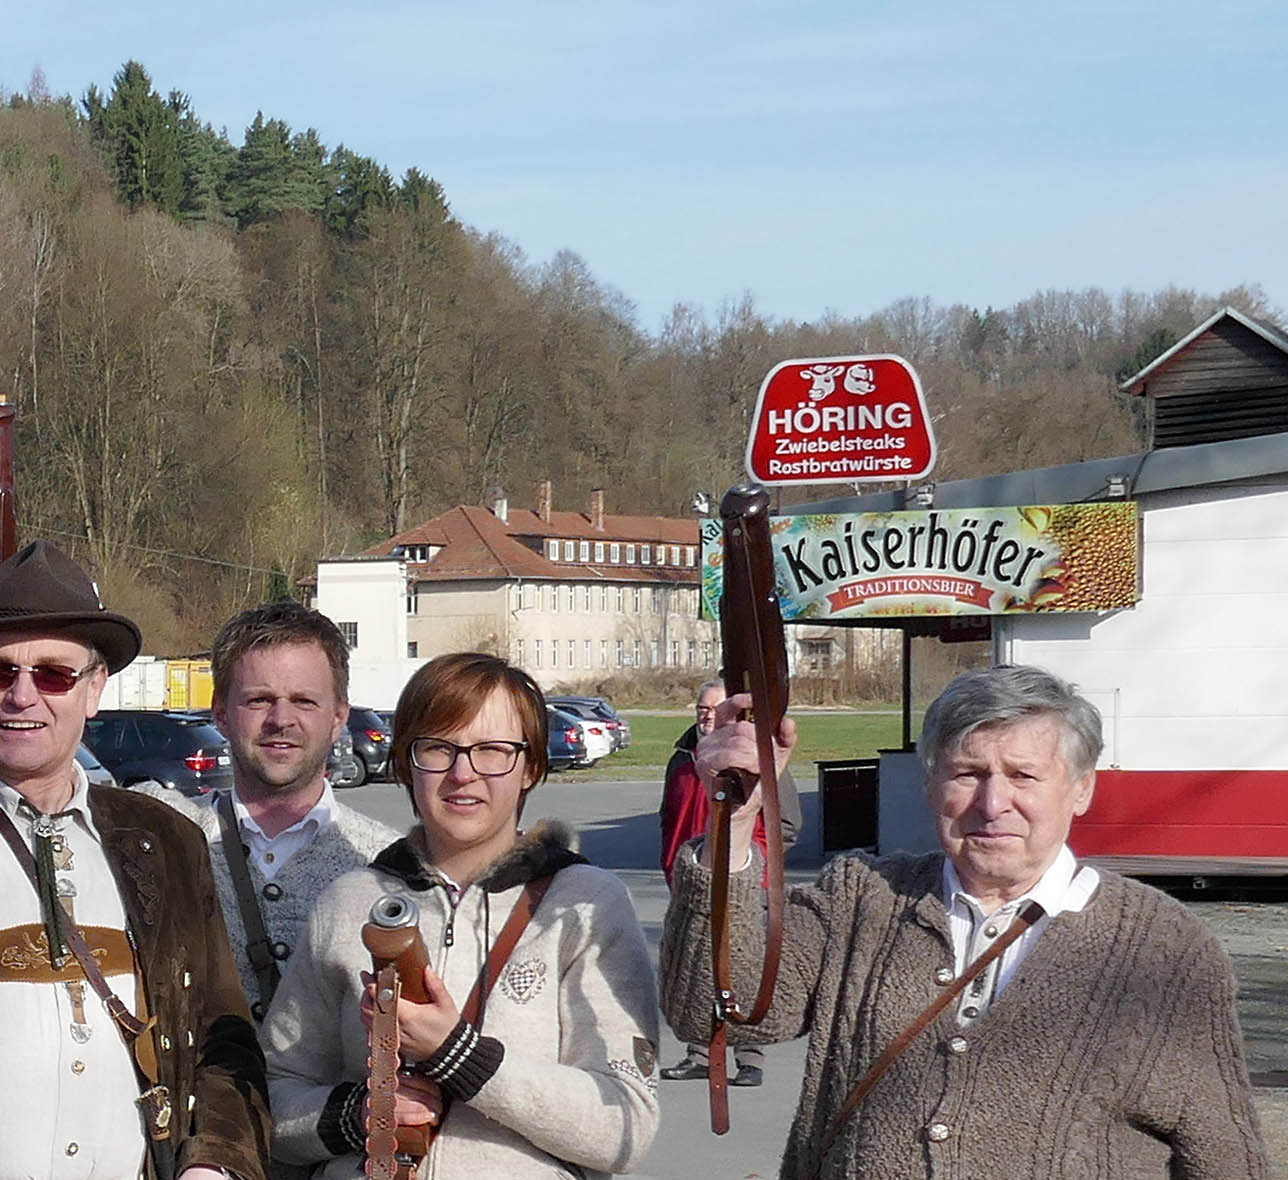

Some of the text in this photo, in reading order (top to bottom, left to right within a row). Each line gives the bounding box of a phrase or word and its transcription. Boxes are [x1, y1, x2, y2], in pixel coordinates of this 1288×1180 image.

[768, 402, 912, 435] HÖRING
[775, 433, 906, 455] Zwiebelsteaks
[769, 455, 913, 475] Rostbratwürste
[781, 513, 1045, 593] Kaiserhöfer
[844, 577, 975, 599] TRADITIONSBIER
